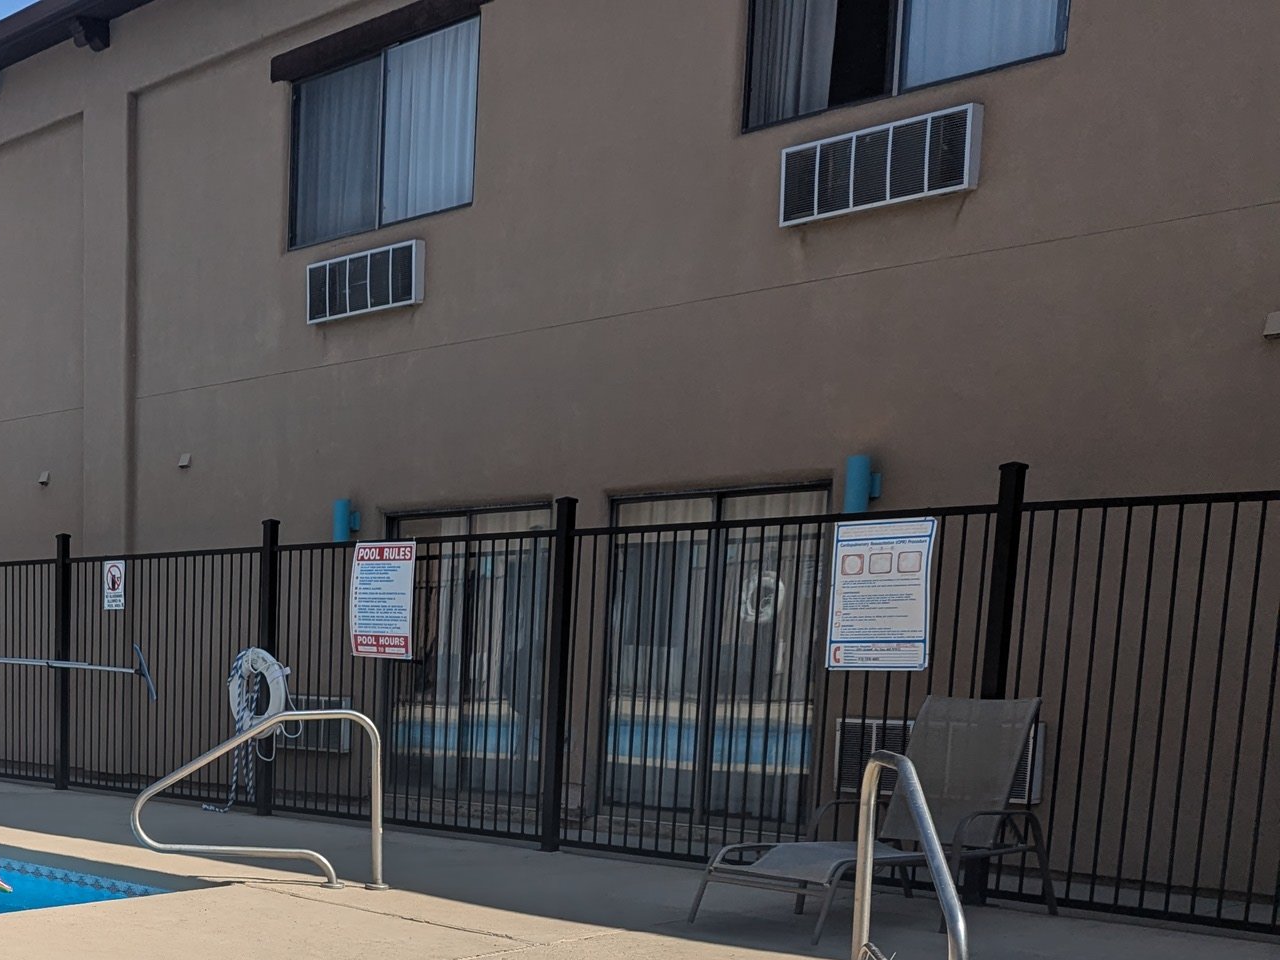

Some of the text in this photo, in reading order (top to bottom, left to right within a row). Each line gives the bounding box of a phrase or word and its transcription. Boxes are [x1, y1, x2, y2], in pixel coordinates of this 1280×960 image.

[358, 547, 411, 560] POOL RULES
[357, 636, 405, 646] POOL HOURS
